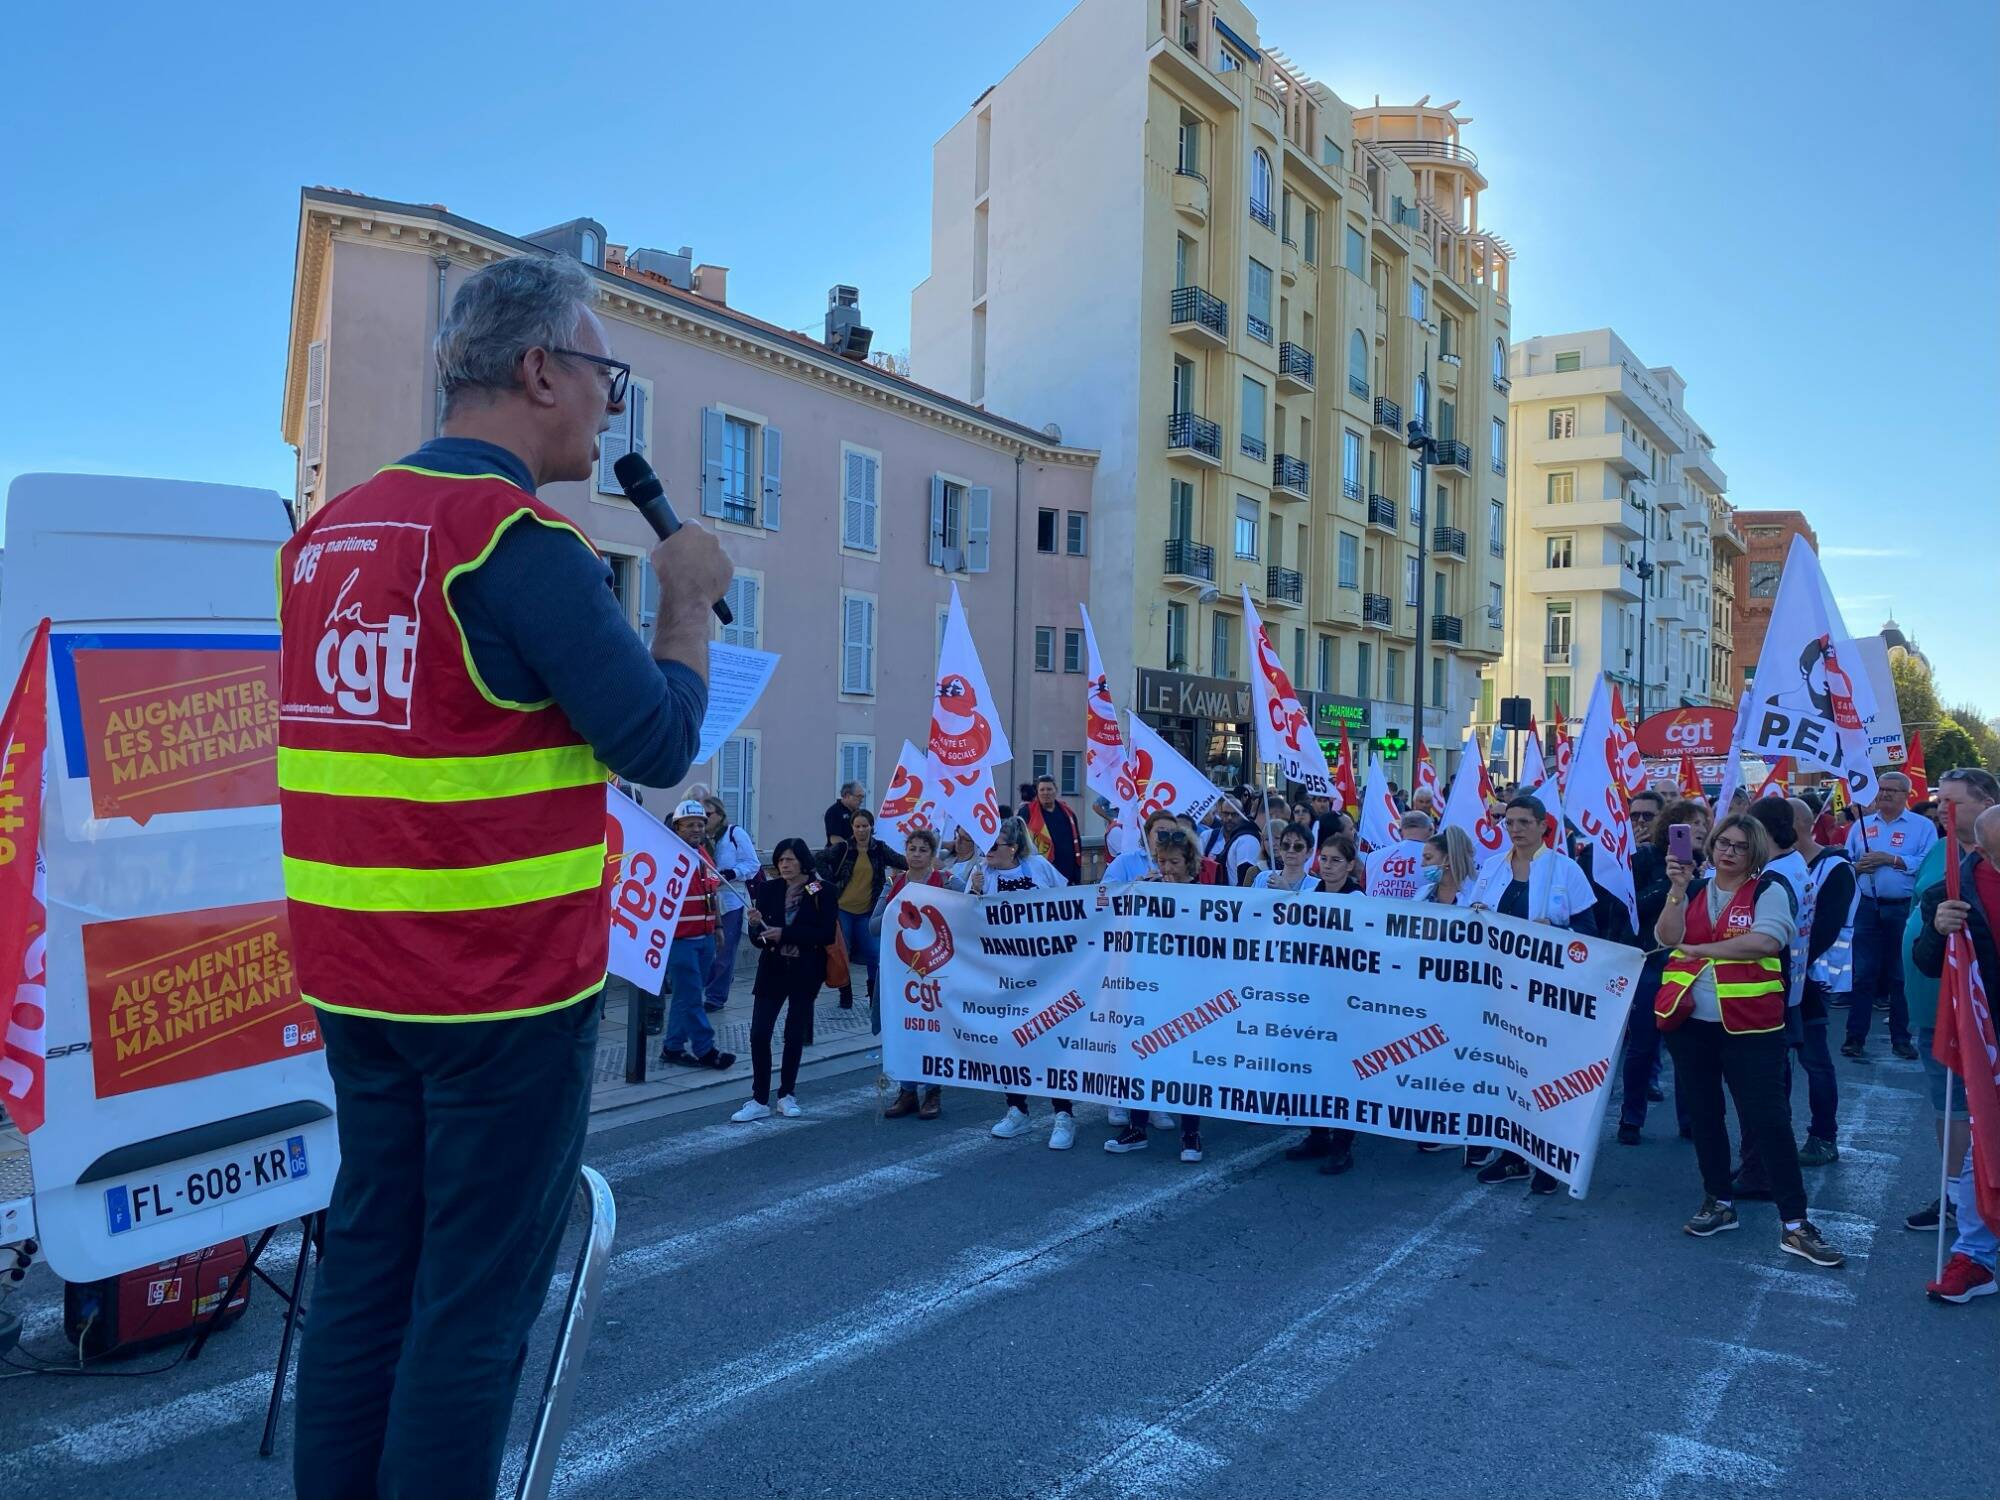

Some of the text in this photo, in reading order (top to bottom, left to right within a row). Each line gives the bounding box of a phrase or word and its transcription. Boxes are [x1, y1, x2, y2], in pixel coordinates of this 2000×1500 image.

[325, 536, 378, 553] maritimes
[294, 551, 323, 585] 06
[315, 614, 416, 716] cgt
[105, 679, 269, 736] AUGMENTER
[1145, 676, 1231, 718] LE KAWA
[1328, 703, 1363, 721] PHARMACIE
[103, 700, 280, 762] LES SALAIRES
[1665, 718, 1714, 747] cgt
[111, 721, 280, 785] MAINTENANT
[1662, 746, 1715, 756] TRANSPORTS
[1382, 855, 1417, 878] cgt
[1376, 879, 1418, 889] HOPITAL
[985, 899, 1087, 926] HÔPITAUX
[1112, 895, 1175, 919] EHPAD
[1200, 899, 1243, 923] PSY
[1273, 902, 1353, 932] SOCIAL
[1386, 913, 1483, 945] MEDICO
[1487, 926, 1565, 969] SOCIAL
[1729, 914, 1753, 927] cgt
[1568, 948, 1586, 961] cgt
[111, 931, 280, 1011] AUGMENTER
[980, 934, 1078, 957] HANDICAP
[1103, 931, 1226, 960] PROTECTION
[1233, 939, 1260, 962] DE
[1264, 940, 1381, 974] L'ENFANCE
[1418, 956, 1503, 991] PUBLIC
[1528, 979, 1596, 1020] PRIVE
[999, 976, 1037, 989] Nice
[1101, 976, 1160, 993] Antibes
[108, 950, 290, 1039] LES SALAIRES
[904, 978, 943, 1012] cgt
[1241, 986, 1310, 1004] Grasse
[1347, 995, 1428, 1019] Cannes
[116, 972, 294, 1062] MAINTENANT
[962, 1001, 1030, 1018] Mougins
[1011, 989, 1086, 1048] DETRESSE
[1090, 1011, 1145, 1028] La Roya
[904, 1017, 940, 1033] USD 06
[953, 1028, 998, 1045] Vence
[1131, 988, 1242, 1060] SOUFFRANCE
[1236, 1020, 1338, 1042] La Bévéra
[1482, 1010, 1548, 1047] Menton
[46, 1042, 92, 1060] SP
[1057, 1036, 1117, 1054] Vallauris
[1351, 1023, 1449, 1081] ASPHYXIE
[1192, 1050, 1312, 1075] Les Paillons
[1454, 1046, 1529, 1079] Vésubie
[1396, 1073, 1532, 1112] Vallée du Var
[922, 1054, 954, 1077] DES
[958, 1059, 1032, 1087] EMPLOIS
[1047, 1068, 1078, 1092] DES
[1082, 1070, 1145, 1101] MOYENS
[1152, 1079, 1212, 1108] POUR
[1219, 1087, 1348, 1121] TRAVAILLER
[1356, 1100, 1382, 1124] ET
[1387, 1104, 1460, 1135] VIVRE
[1467, 1116, 1580, 1174] DIGNEMENT
[292, 1159, 306, 1173] 06
[132, 1149, 288, 1222] FL-608-KR
[117, 1212, 123, 1224] F
